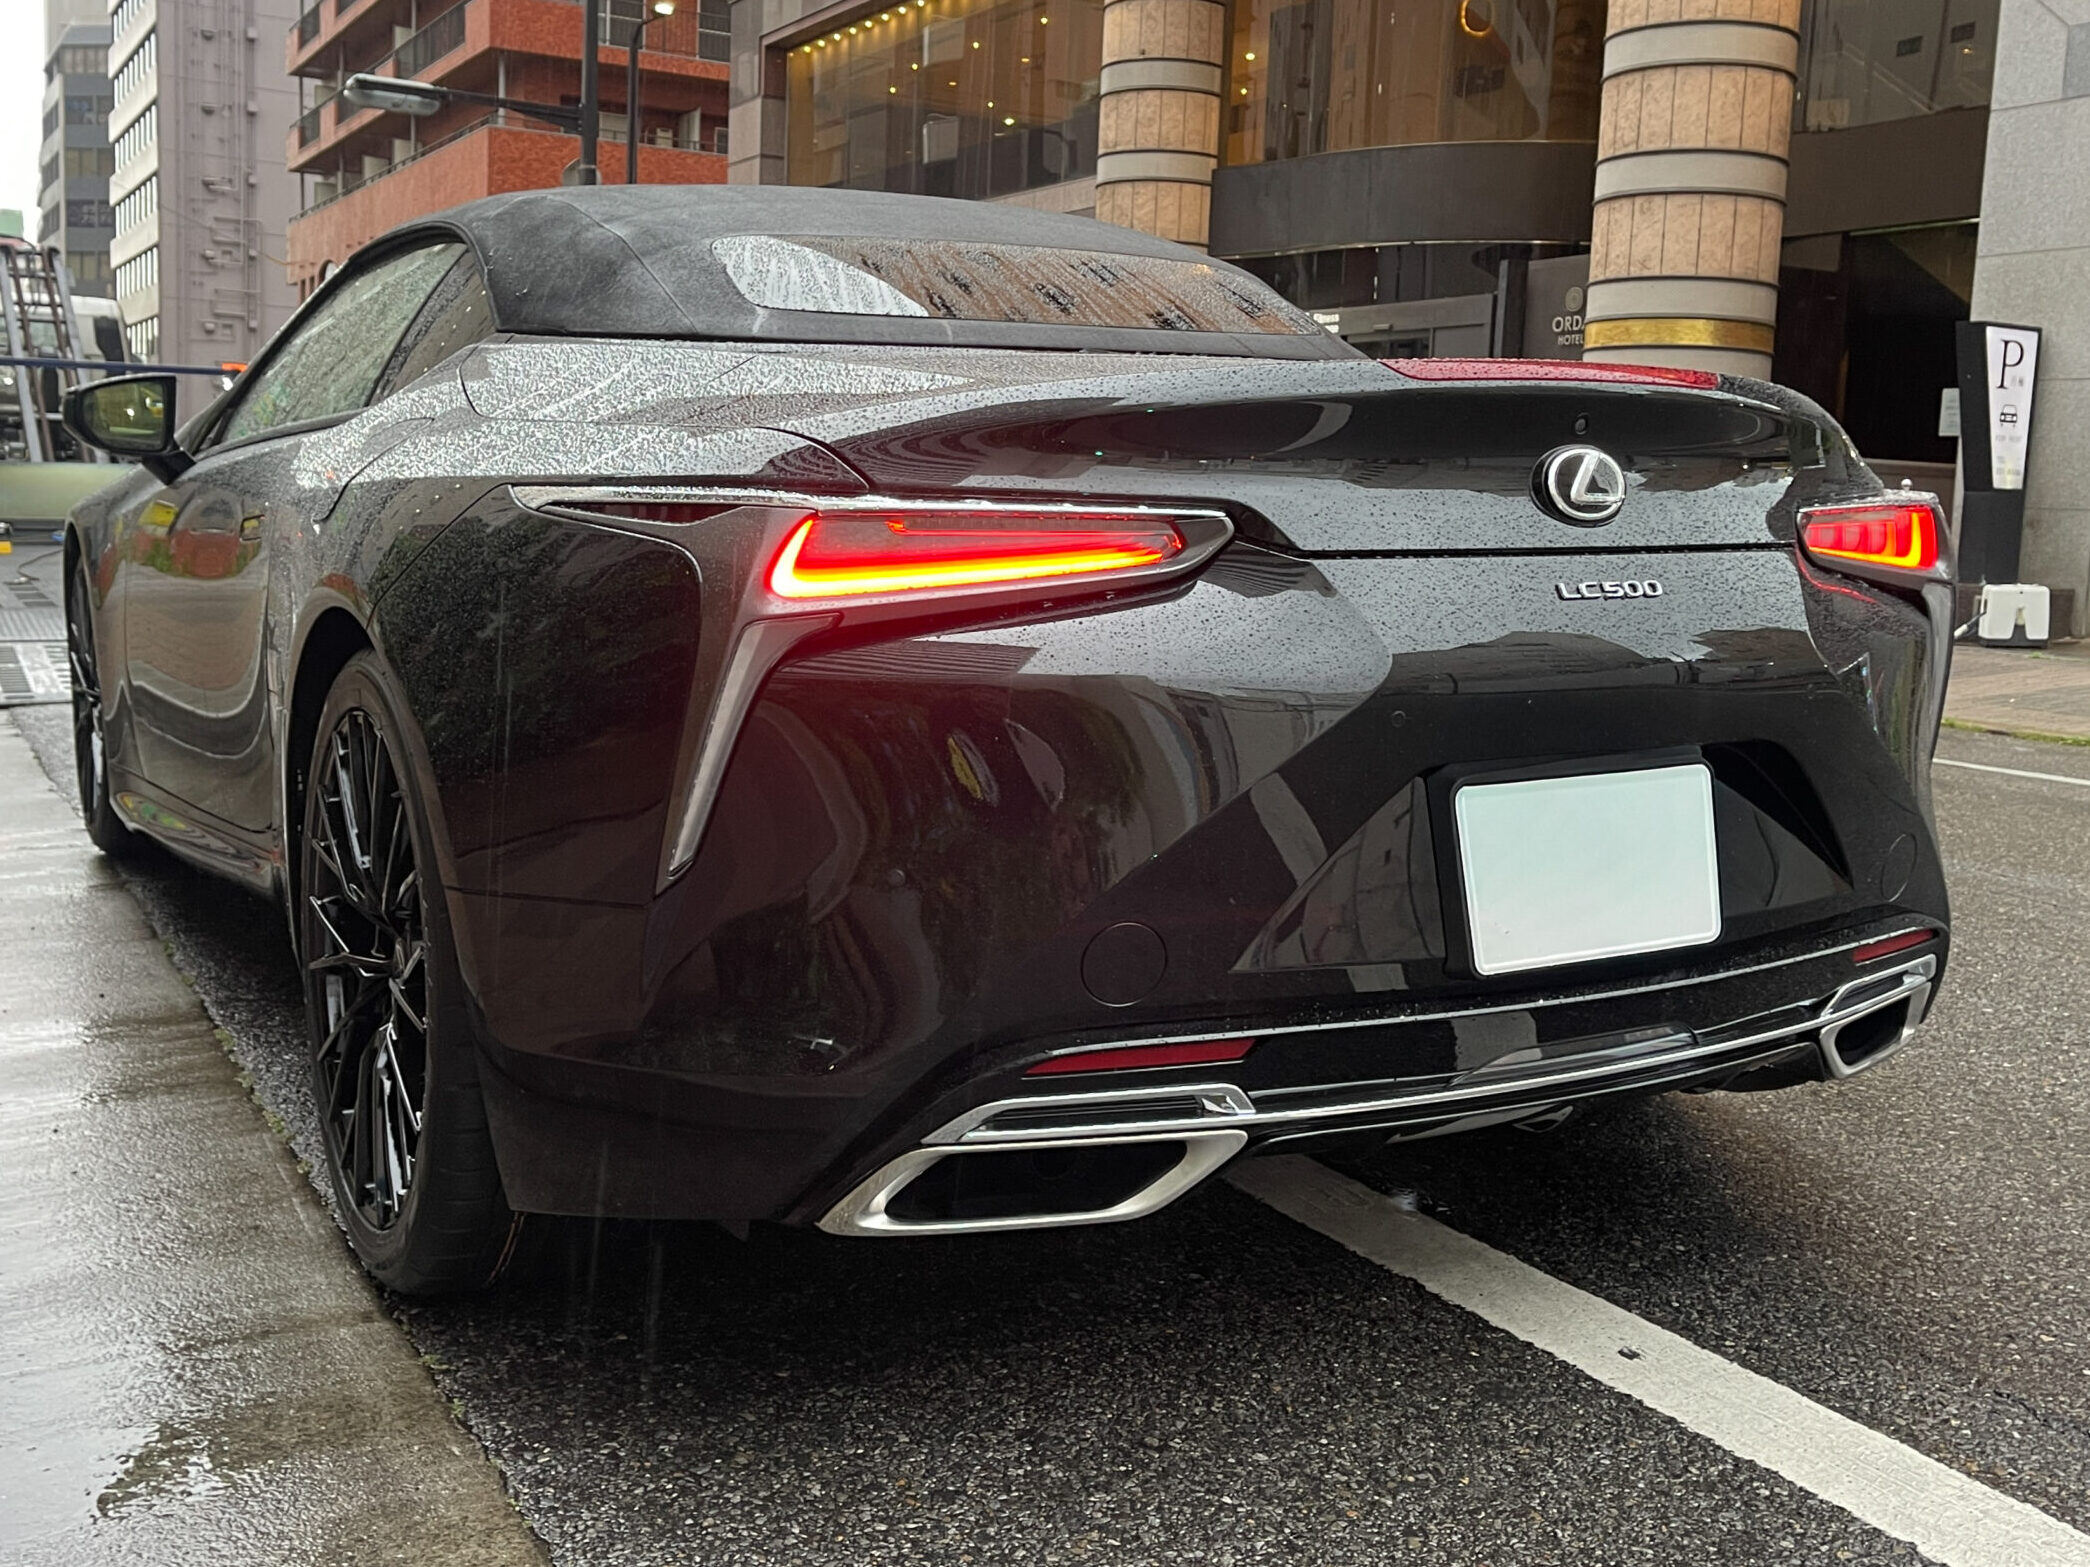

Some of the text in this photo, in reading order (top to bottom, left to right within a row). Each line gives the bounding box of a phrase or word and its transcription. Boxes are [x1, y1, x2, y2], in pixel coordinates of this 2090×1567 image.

[1558, 334, 1584, 345] HOTEL
[1996, 339, 2024, 389] P
[1556, 580, 1663, 600] LC500
